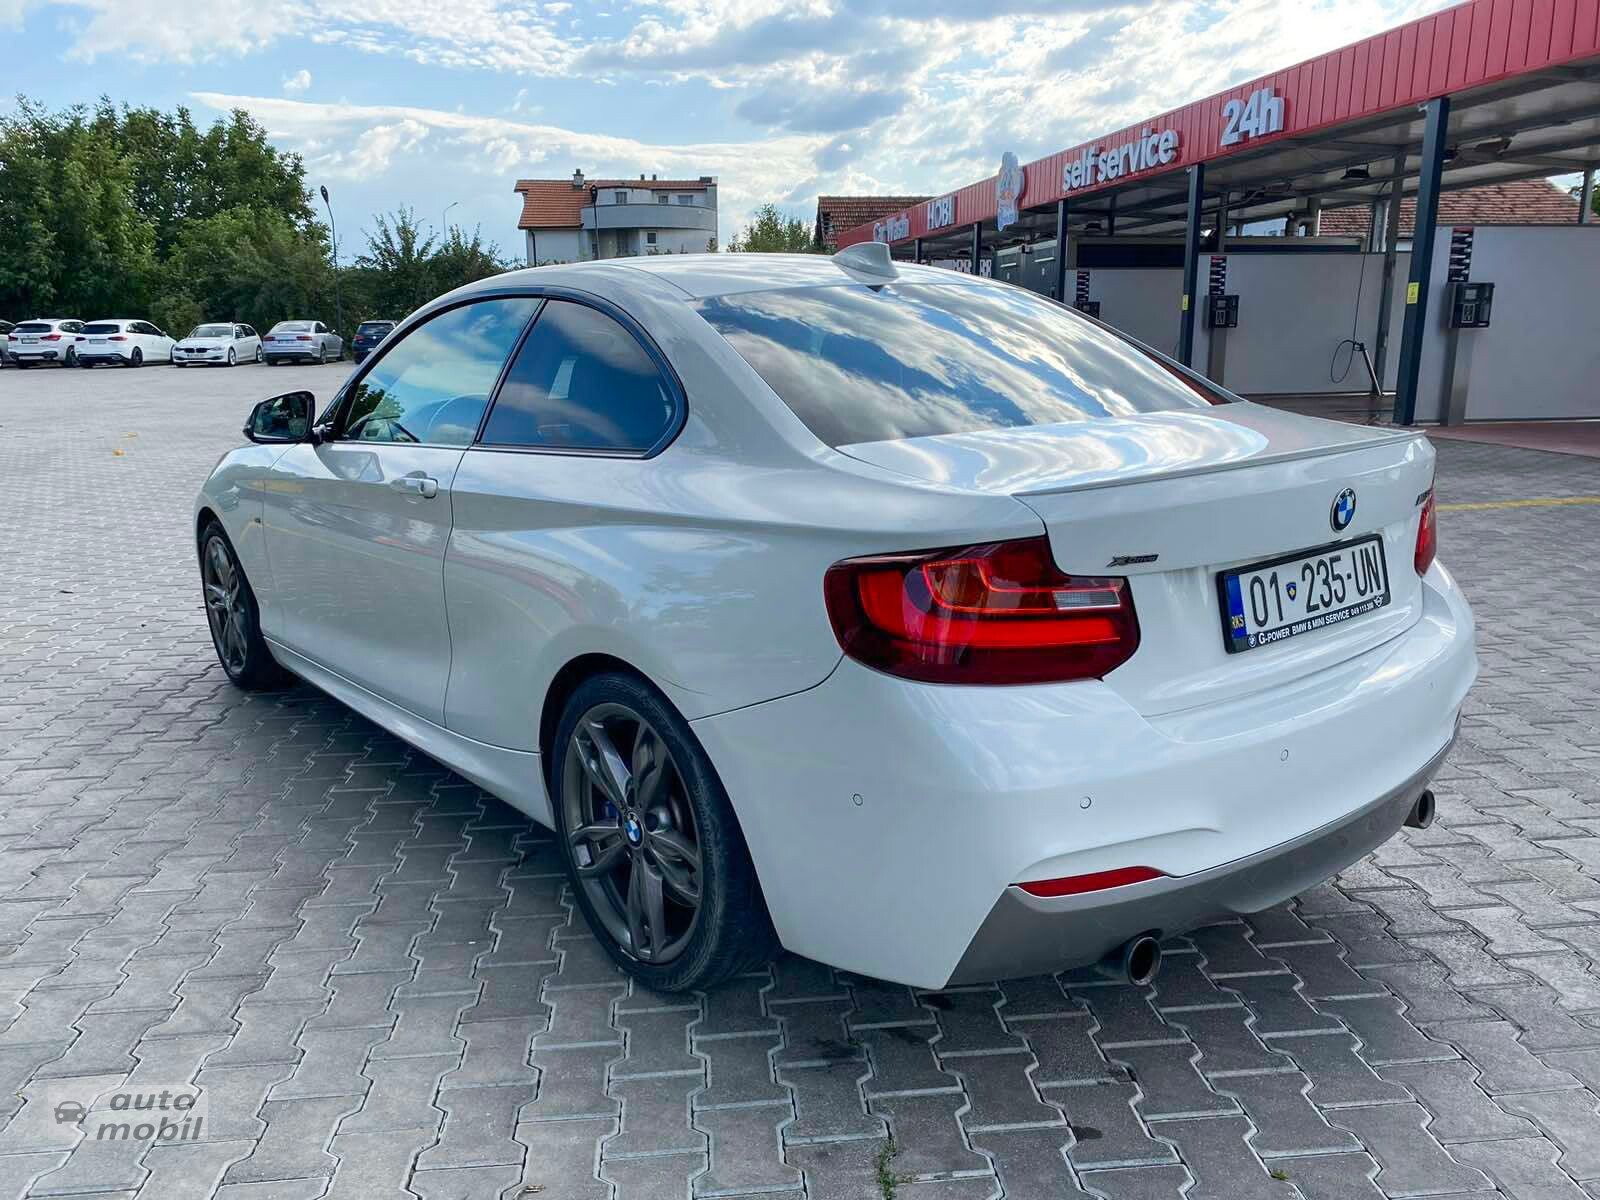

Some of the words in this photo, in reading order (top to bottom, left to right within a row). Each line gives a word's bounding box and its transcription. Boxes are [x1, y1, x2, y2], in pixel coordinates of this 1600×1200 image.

[1221, 87, 1285, 146] 24h
[1063, 145, 1099, 192] self
[1097, 128, 1178, 182] service
[927, 194, 956, 231] HOBI
[1250, 571, 1284, 627] 01
[1302, 545, 1382, 613] 235-UN
[1258, 628, 1290, 645] G-POWER
[1292, 621, 1307, 635] BMW
[1307, 620, 1313, 631] &
[1312, 616, 1326, 629] MINI
[1325, 609, 1350, 625] SERVICE
